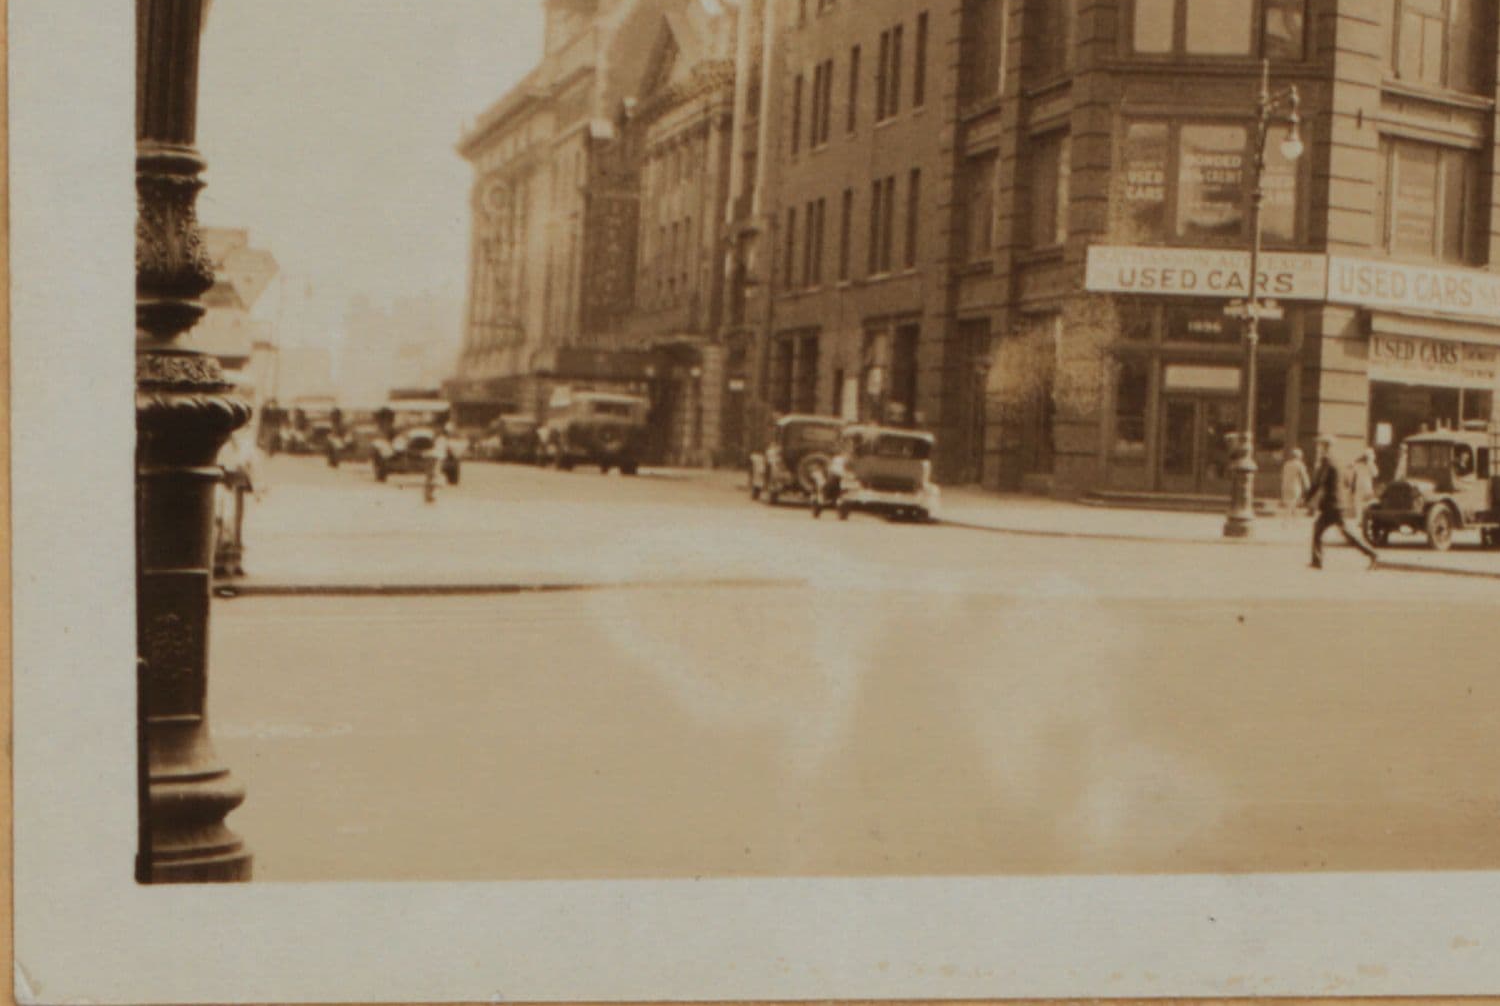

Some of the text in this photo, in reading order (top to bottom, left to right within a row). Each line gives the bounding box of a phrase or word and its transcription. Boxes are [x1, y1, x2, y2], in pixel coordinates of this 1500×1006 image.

[1117, 267, 1295, 295] USED CARS
[1338, 265, 1407, 300] USED
[1414, 272, 1474, 308] CARS
[1373, 336, 1416, 362] USED
[1420, 340, 1459, 365] CARS
